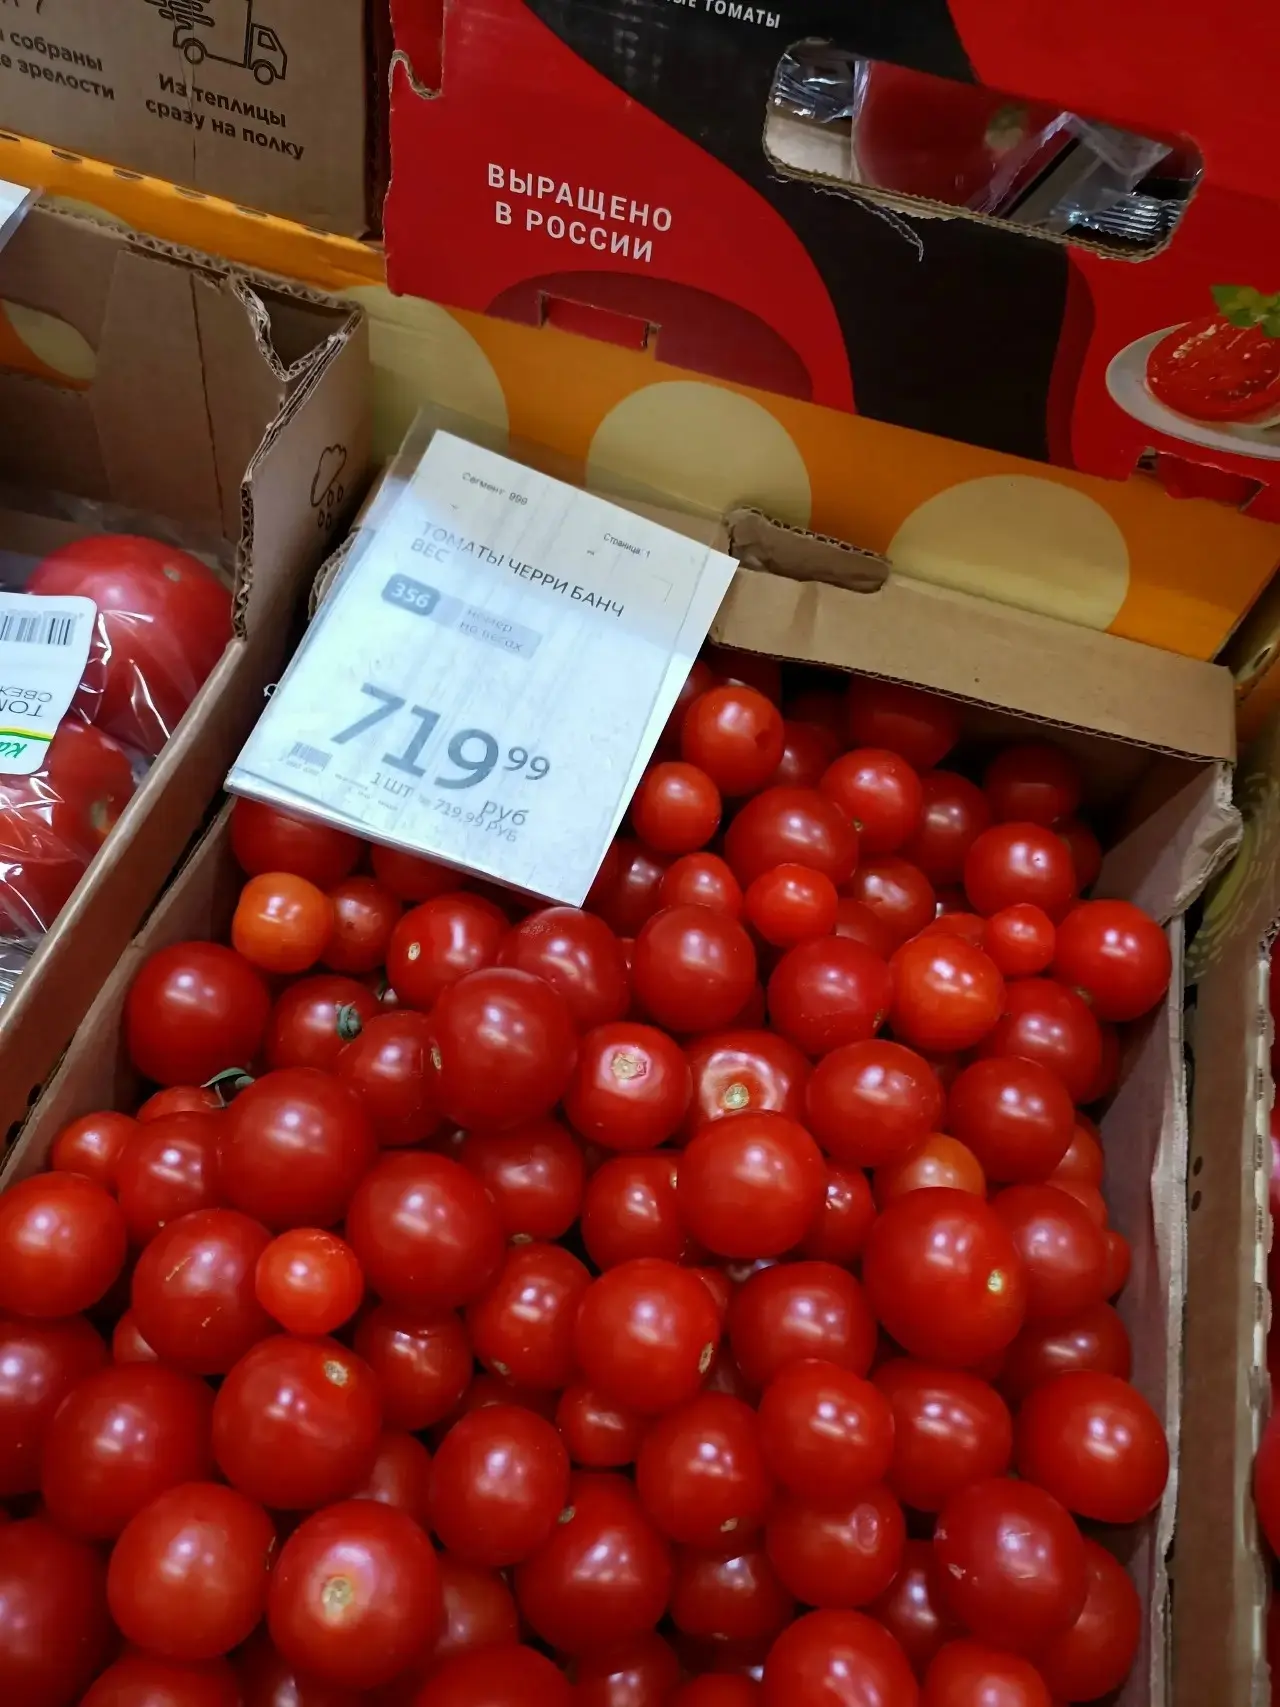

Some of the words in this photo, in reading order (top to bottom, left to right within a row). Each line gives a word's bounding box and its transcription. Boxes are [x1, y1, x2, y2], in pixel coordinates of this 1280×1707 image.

[705, 0, 781, 28] ТОМАТЫ
[10, 34, 103, 72] собраны
[18, 63, 116, 101] зрелости
[158, 73, 187, 97] Из
[190, 89, 287, 128] теплицы
[145, 99, 205, 131] сразу
[211, 120, 236, 139] на
[242, 131, 304, 161] полку
[488, 163, 672, 232] ВЫРАЩЕНО
[495, 201, 513, 226] В
[526, 209, 654, 263] РОССИИ
[411, 537, 451, 564] ВЕС
[422, 521, 503, 567] ТОМАТЫ
[507, 560, 569, 596] ЧЕРРИ
[569, 585, 626, 619] БАНЧ
[389, 582, 431, 610] 356
[482, 628, 524, 653] веах
[330, 682, 500, 790] 719
[504, 746, 551, 782] 99
[383, 777, 414, 799] ШТ
[480, 799, 529, 827] руб
